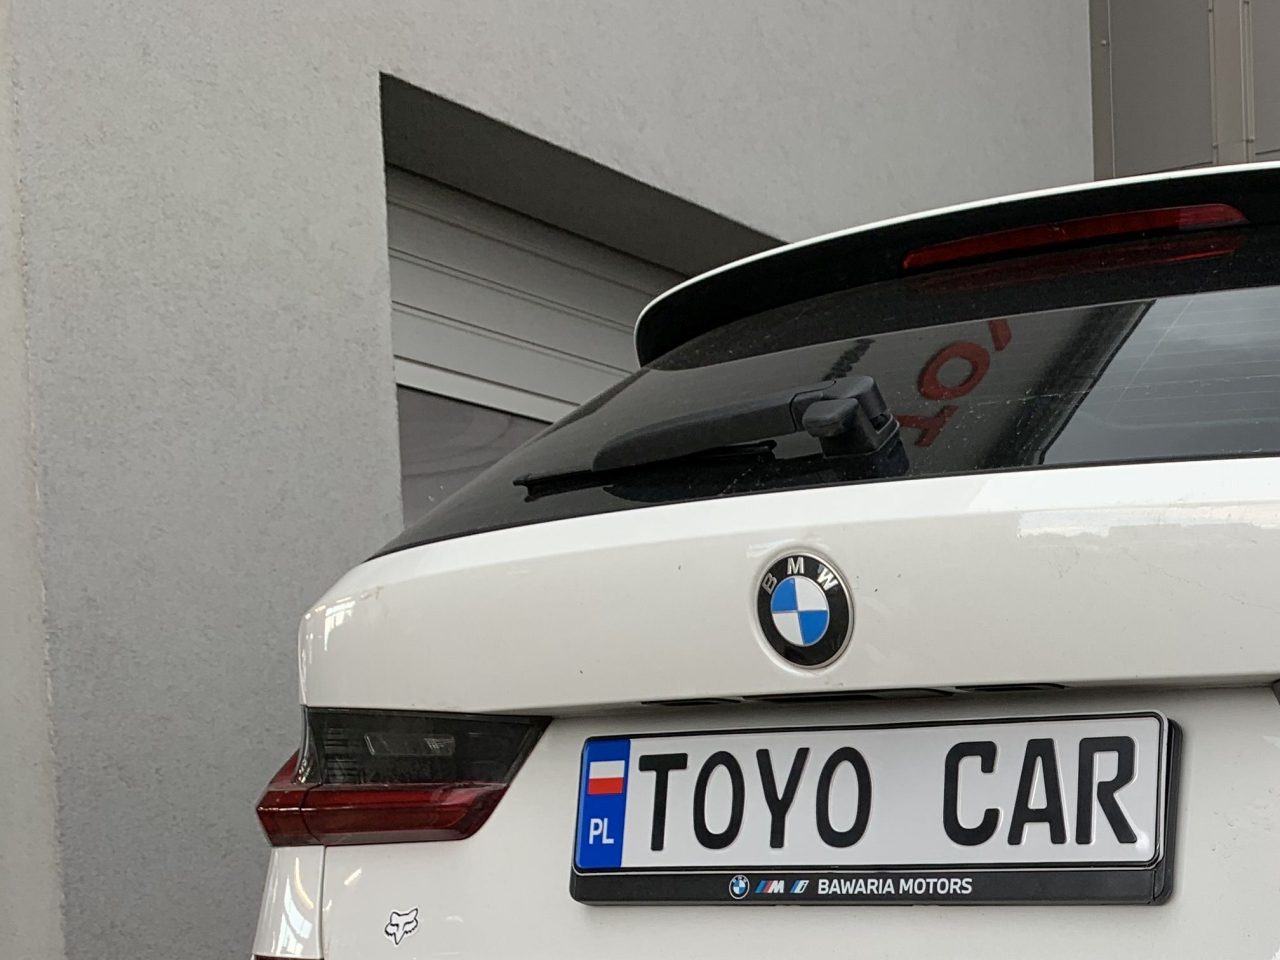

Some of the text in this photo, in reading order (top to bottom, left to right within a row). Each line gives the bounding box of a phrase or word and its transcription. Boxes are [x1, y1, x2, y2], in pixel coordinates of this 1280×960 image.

[762, 557, 839, 595] BMW
[638, 736, 1138, 851] TOYO CAR
[589, 817, 615, 845] PL
[817, 878, 895, 895] BAWARIA
[899, 878, 973, 895] MOTORS
